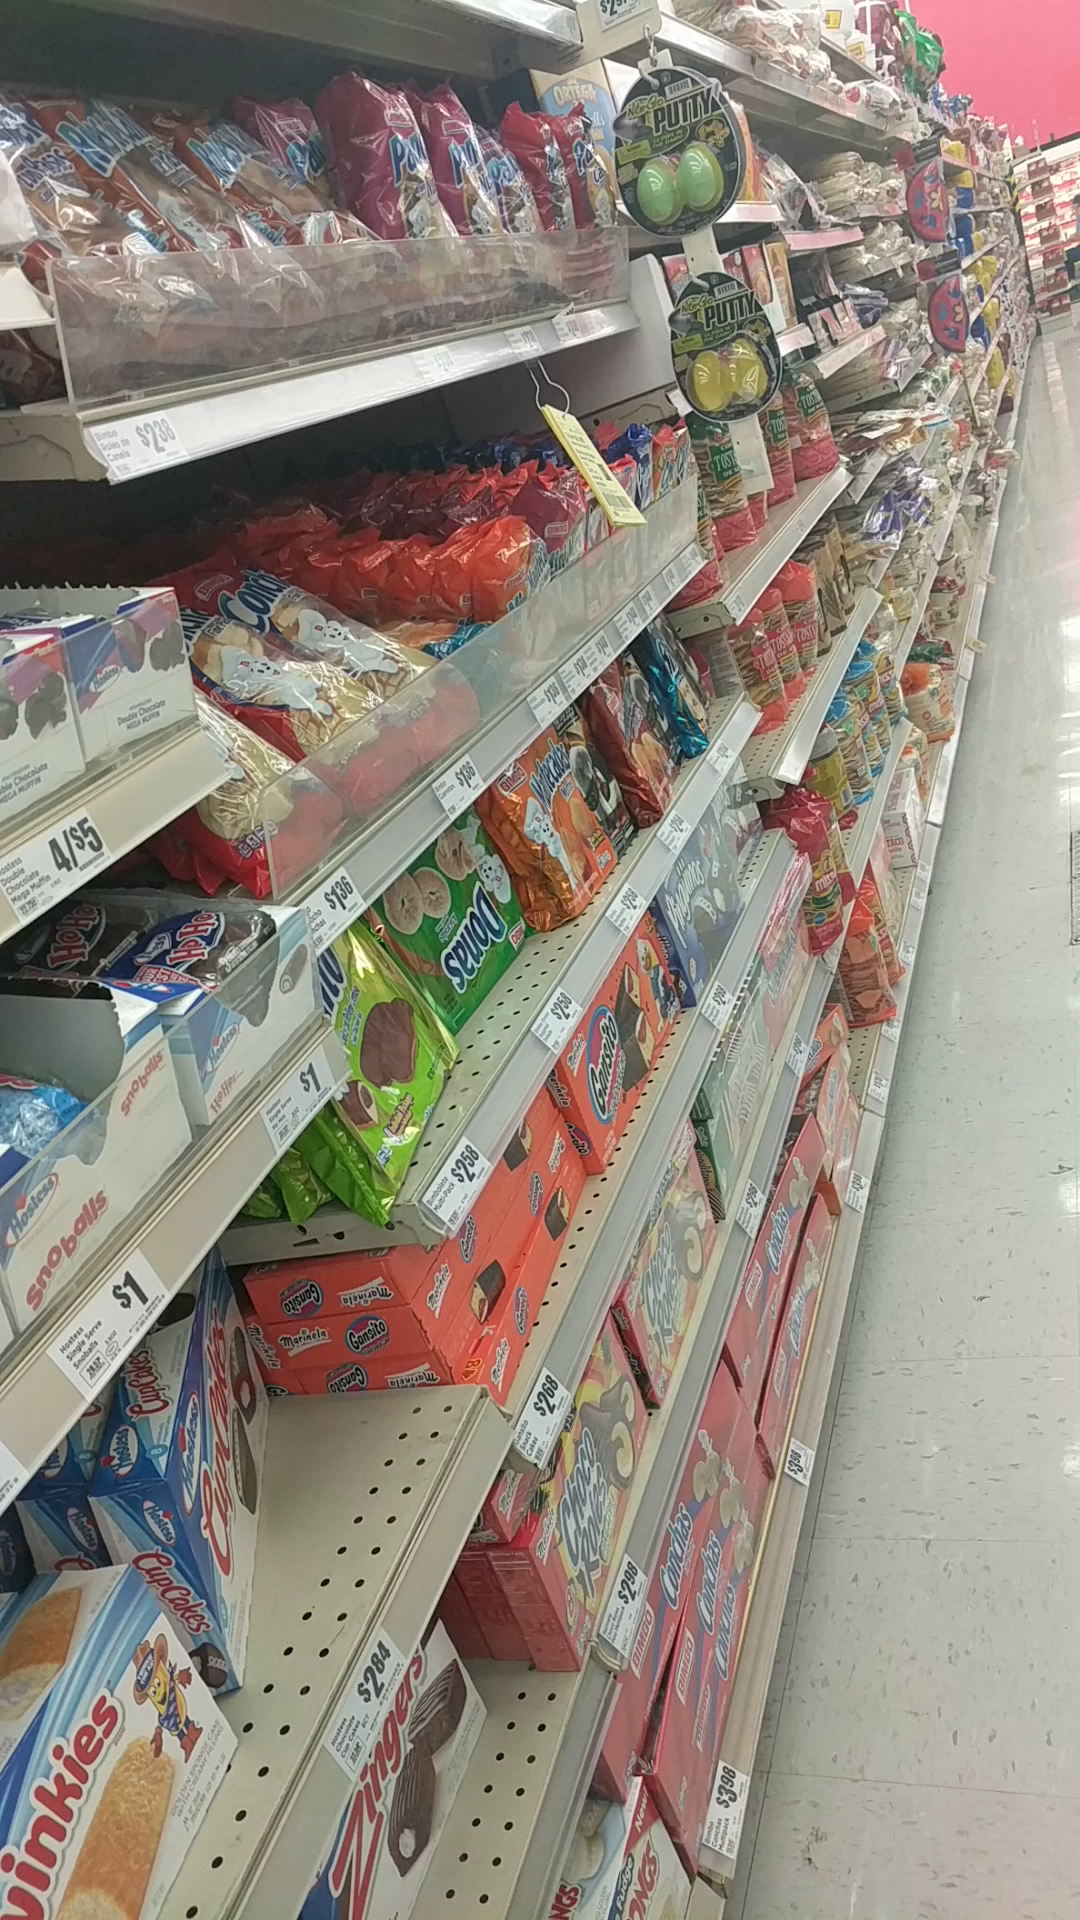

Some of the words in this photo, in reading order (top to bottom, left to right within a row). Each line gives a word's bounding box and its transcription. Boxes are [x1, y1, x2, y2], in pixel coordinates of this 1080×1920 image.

[553, 83, 597, 106] ORTEGA
[653, 86, 716, 137] PUTTY
[704, 290, 755, 331] PUTTY
[117, 708, 138, 725] Double
[137, 699, 166, 718] Chocolate
[13, 763, 48, 785] Chocolate
[455, 761, 476, 789] $136
[499, 765, 526, 792] BIMBO
[48, 816, 103, 872] 4/$5
[886, 836, 904, 848] TACO
[0, 857, 22, 876] ostess
[0, 867, 26, 887] Double
[5, 870, 40, 895] Chocolate
[10, 889, 31, 905] Mega
[324, 875, 354, 911] $136
[440, 880, 508, 995] Donas
[550, 991, 573, 1020] $258
[207, 1024, 238, 1070] Hostess
[589, 1012, 618, 1120] Gansito
[119, 1049, 164, 1117] snoballs
[299, 1062, 322, 1093] $1
[549, 1068, 570, 1109] Marinela
[450, 1144, 480, 1183] $258
[9, 1175, 56, 1241] Hostess
[426, 1176, 449, 1207] Bimbolete
[433, 1182, 456, 1213] Multi-Pack
[25, 1188, 109, 1312] snoballs
[112, 1270, 149, 1310] $1
[282, 1281, 321, 1314] Gansito
[341, 1284, 394, 1308] Marinela
[59, 1326, 84, 1354] Hostess
[66, 1339, 86, 1362] Single
[84, 1319, 103, 1341] Serve
[72, 1340, 99, 1370] Snoballs
[247, 1323, 281, 1369] Marinela
[278, 1327, 328, 1349] Marinela
[347, 1319, 387, 1352] Gansito
[533, 1374, 559, 1417] $268
[111, 1426, 131, 1476] Hostess
[181, 1393, 200, 1506] Hostess
[514, 1419, 529, 1445] Gansito
[520, 1430, 533, 1452] Snack
[526, 1436, 539, 1457] Cakes
[787, 1449, 804, 1475] $398
[144, 1501, 176, 1546] Hostess
[660, 1501, 693, 1611] Conchas
[132, 1549, 212, 1635] CupCakes
[617, 1560, 638, 1605] $298
[697, 1530, 722, 1636] Conchas
[631, 1606, 654, 1672] BIMBO
[714, 1583, 736, 1681] Conchas
[357, 1639, 392, 1703] $284
[677, 1637, 695, 1700] BIMBO
[330, 1717, 348, 1747] Hostess
[335, 1714, 356, 1753] Chocolate
[340, 1742, 350, 1759] Cup
[347, 1720, 361, 1743] Cakes
[171, 1775, 192, 1816] GOLDEN
[189, 1740, 210, 1777] SPONGE
[207, 1717, 221, 1740] CAKE
[177, 1792, 191, 1818] WITH
[189, 1757, 209, 1793] CREAMY
[207, 1725, 224, 1757] FILLING
[331, 1652, 423, 1920] Zingers
[715, 1765, 738, 1809] $398
[635, 1785, 650, 1833] New!
[704, 1820, 715, 1845] Bimbo
[711, 1817, 723, 1848] Conchas
[718, 1817, 730, 1852] Multipack
[616, 1854, 635, 1911] Fudge
